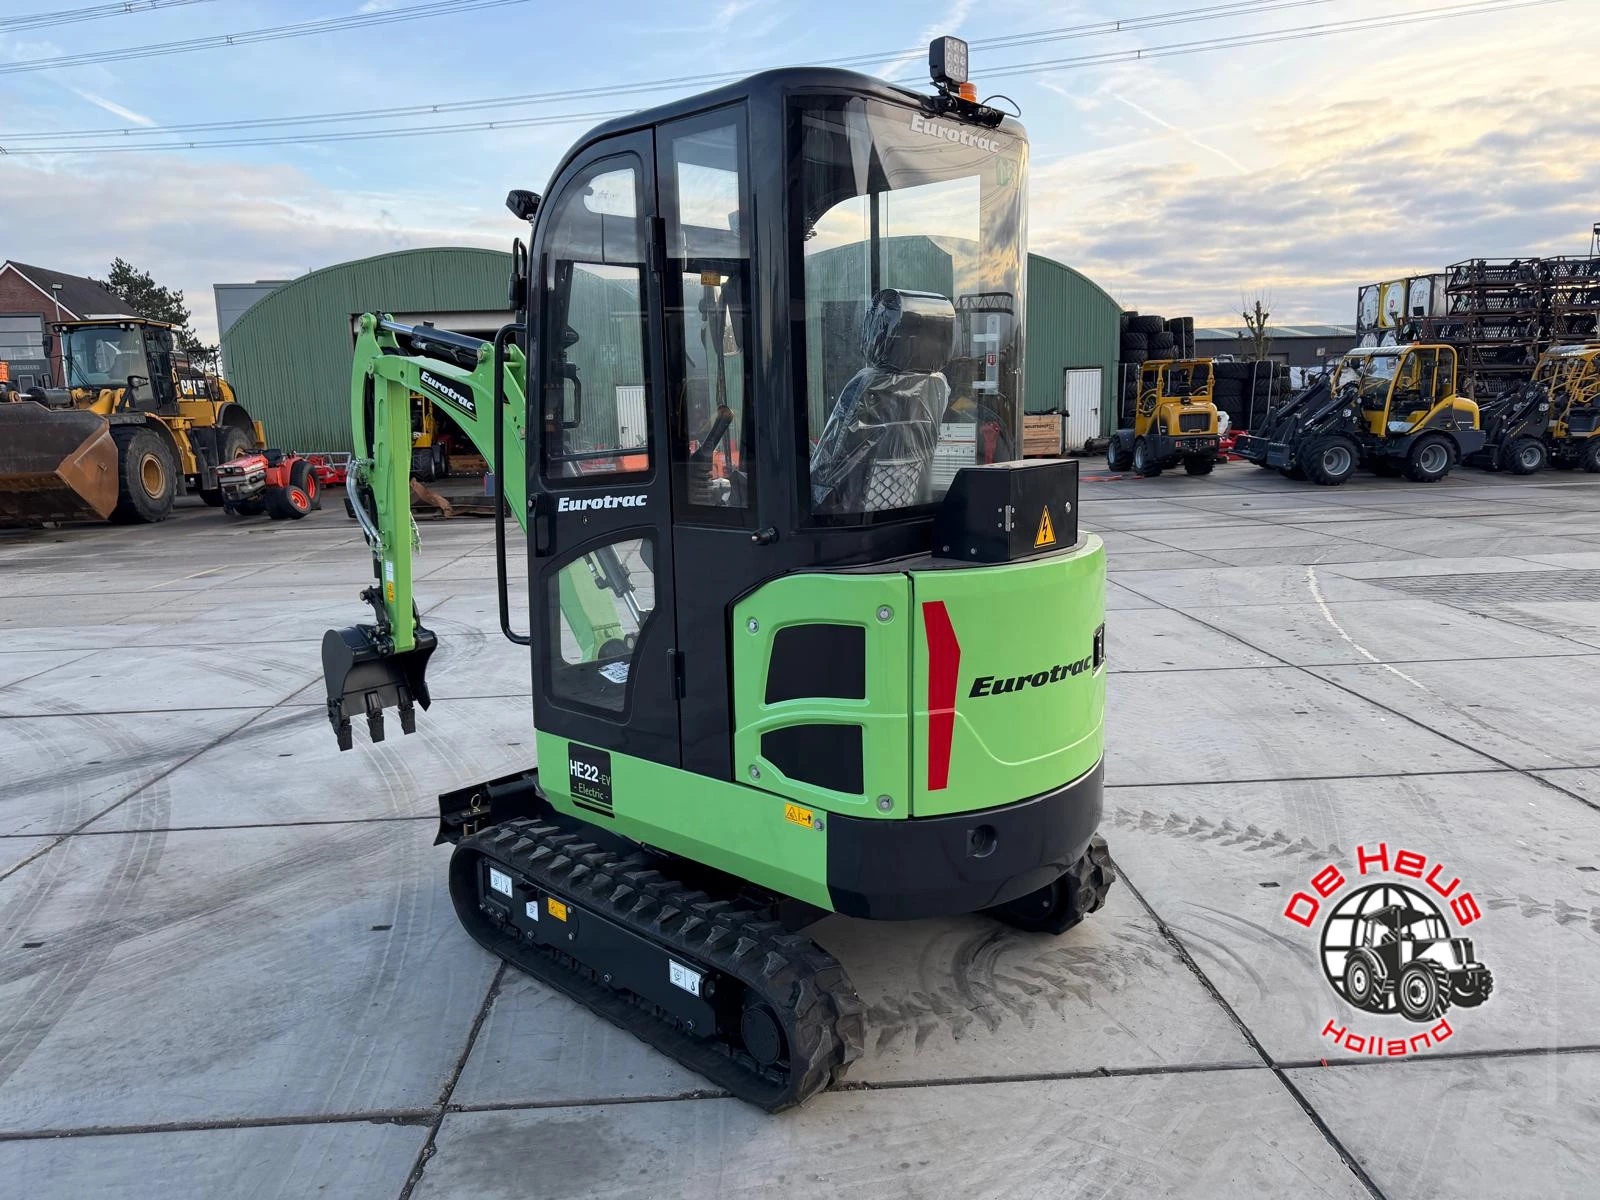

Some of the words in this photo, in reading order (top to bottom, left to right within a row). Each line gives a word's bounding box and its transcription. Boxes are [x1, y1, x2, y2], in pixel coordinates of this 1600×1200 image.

[910, 113, 1000, 153] Eurotrac
[420, 371, 475, 411] Eurotrac
[557, 494, 648, 513] Eurotrac
[968, 655, 1092, 699] Eurotrac
[578, 782, 604, 800] Electric
